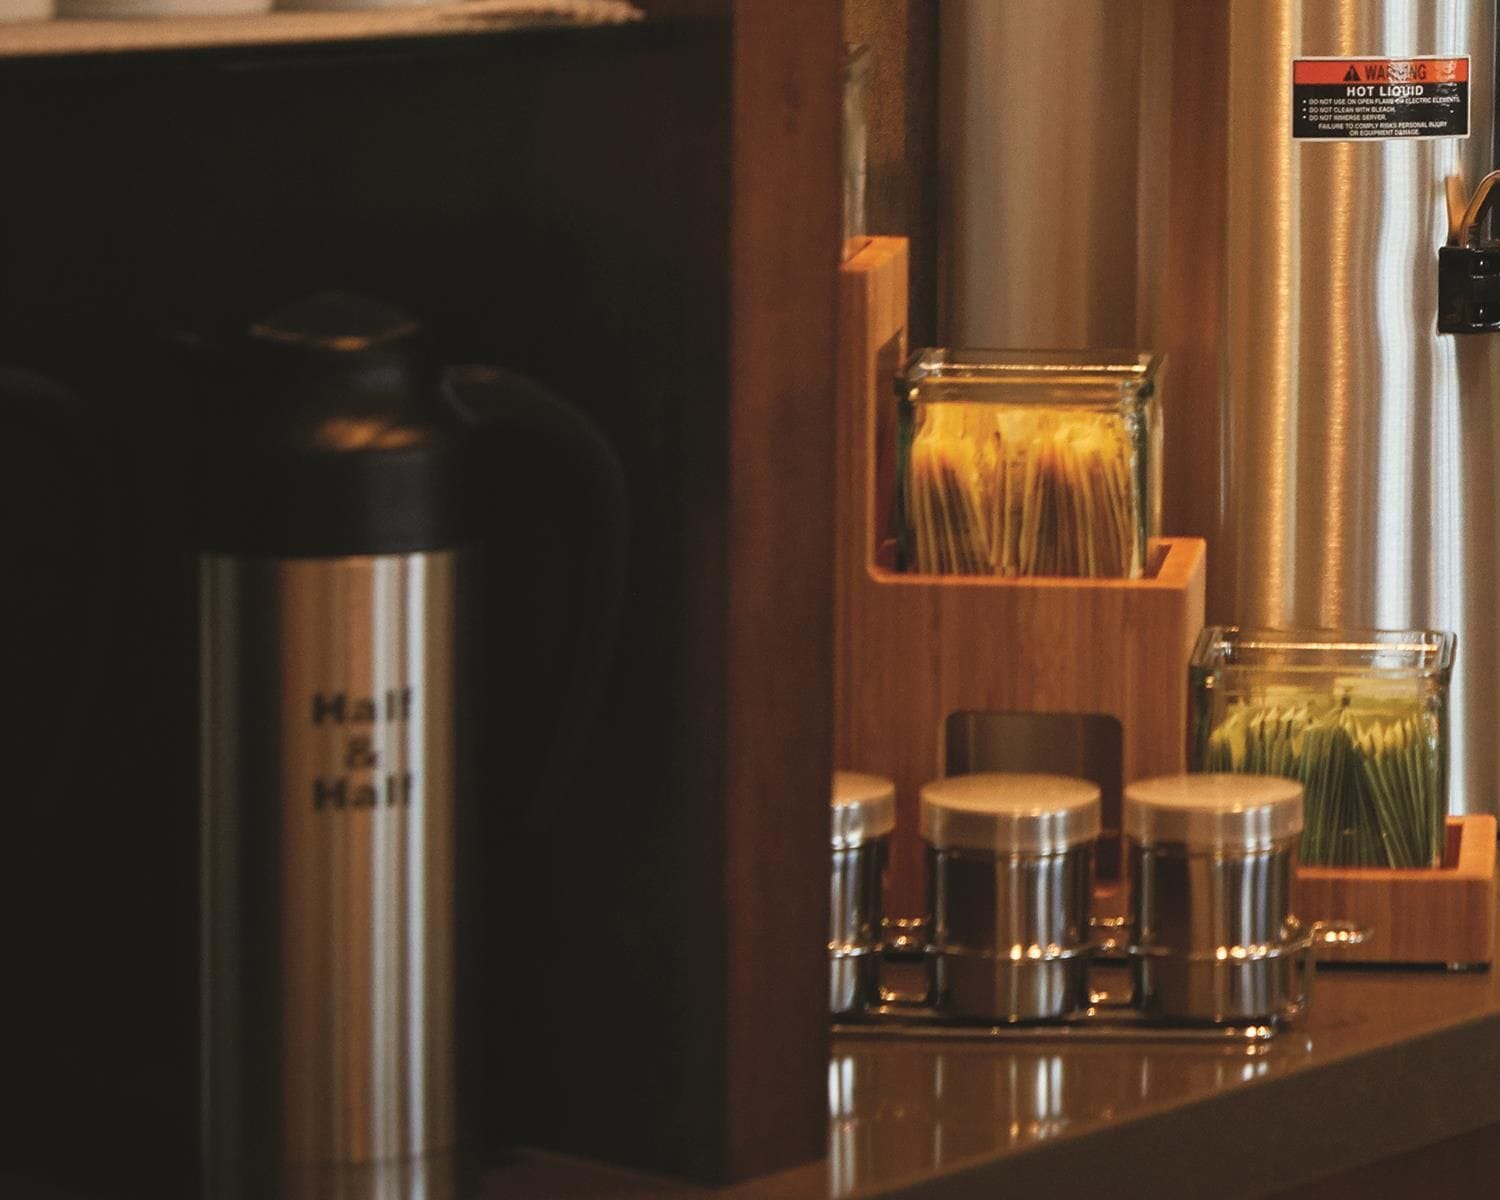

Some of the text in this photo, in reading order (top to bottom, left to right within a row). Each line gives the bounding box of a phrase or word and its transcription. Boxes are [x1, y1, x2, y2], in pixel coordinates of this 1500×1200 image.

[1365, 64, 1427, 81] WARNG
[1347, 85, 1424, 96] HOT LIQUID
[312, 688, 413, 726] Half
[347, 738, 377, 770] &
[312, 774, 413, 812] Half
